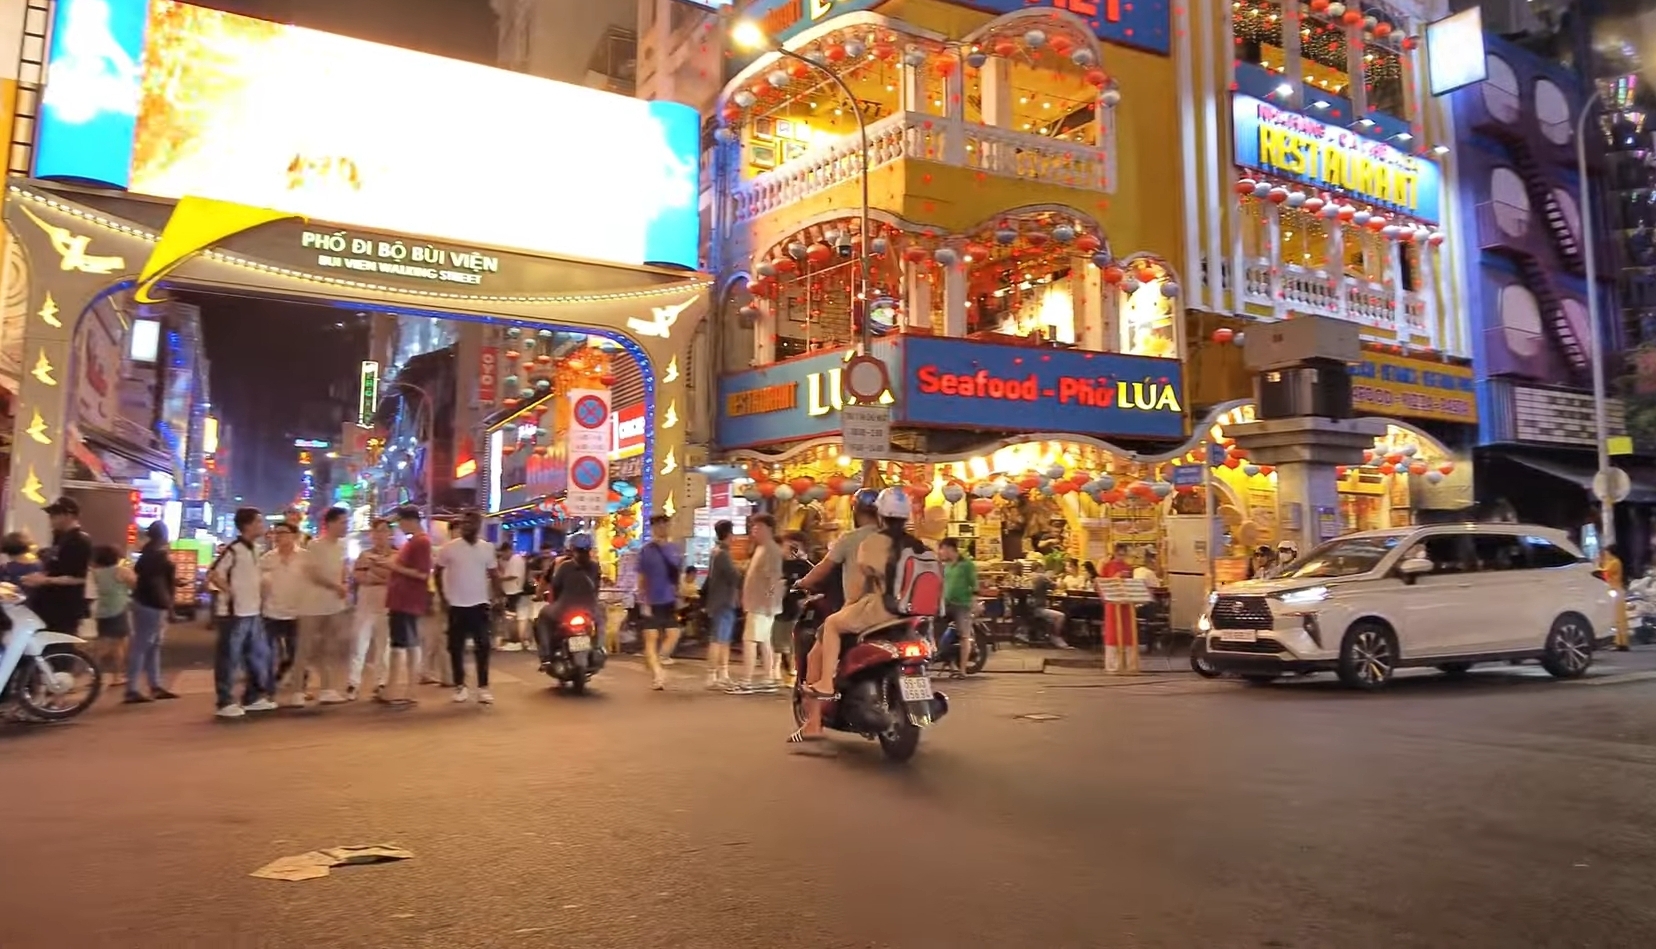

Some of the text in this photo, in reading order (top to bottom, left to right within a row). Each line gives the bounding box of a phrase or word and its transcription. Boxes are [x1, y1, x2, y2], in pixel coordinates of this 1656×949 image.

[302, 231, 498, 273] PHỐ ĐI BỘ BÙI VIỆN
[482, 353, 494, 385] OYO
[917, 364, 1038, 401] Seafood
